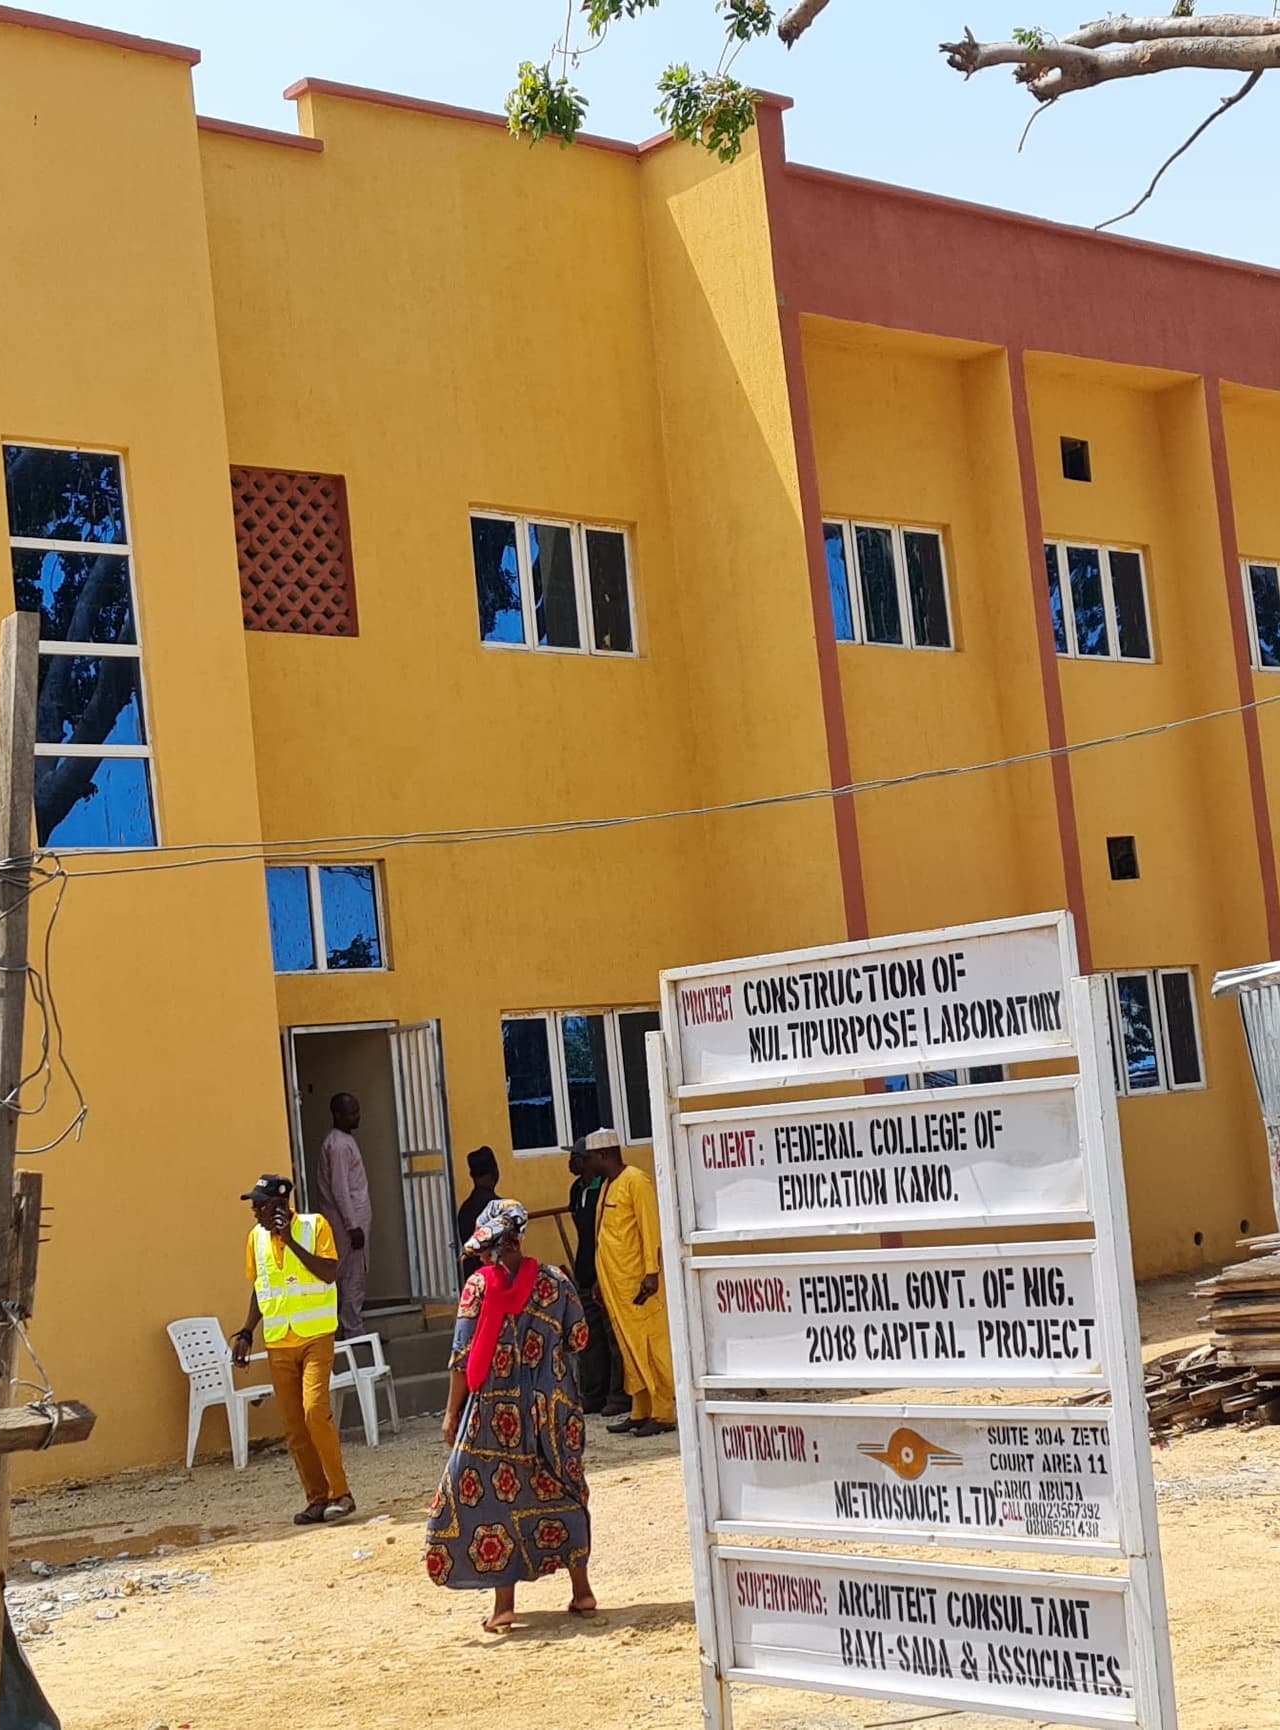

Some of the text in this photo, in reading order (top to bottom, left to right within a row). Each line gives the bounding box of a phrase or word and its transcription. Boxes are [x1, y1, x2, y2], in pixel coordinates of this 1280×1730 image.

[682, 952, 966, 1026] PROJECT CONSTRUCTION OF
[748, 990, 1063, 1063] MULTIPURPOSE LABORATORY
[774, 1120, 863, 1164] FEDERAL
[869, 1111, 967, 1156] COLLEGE
[974, 1110, 1003, 1149] OF
[778, 1164, 959, 1211] EDUCATION KANO.
[716, 1267, 1074, 1314] SPONSOR: FEDERAL GOVT. OF NIG.
[806, 1318, 1095, 1363] 2018 CAPITAL PROJECT
[987, 1426, 1029, 1446] SUITE
[1034, 1427, 1065, 1446] 304
[990, 1453, 1108, 1474] COURT AREA 11
[833, 1480, 1004, 1527] METROSOUCE LTD.
[993, 1480, 1084, 1501] GARKI ABUJA
[736, 1571, 1090, 1640] SUPERVISORS: ARCHITECT CONSULTANT
[839, 1626, 1131, 1700] BAYI-SADA & ASSOCIATES.
